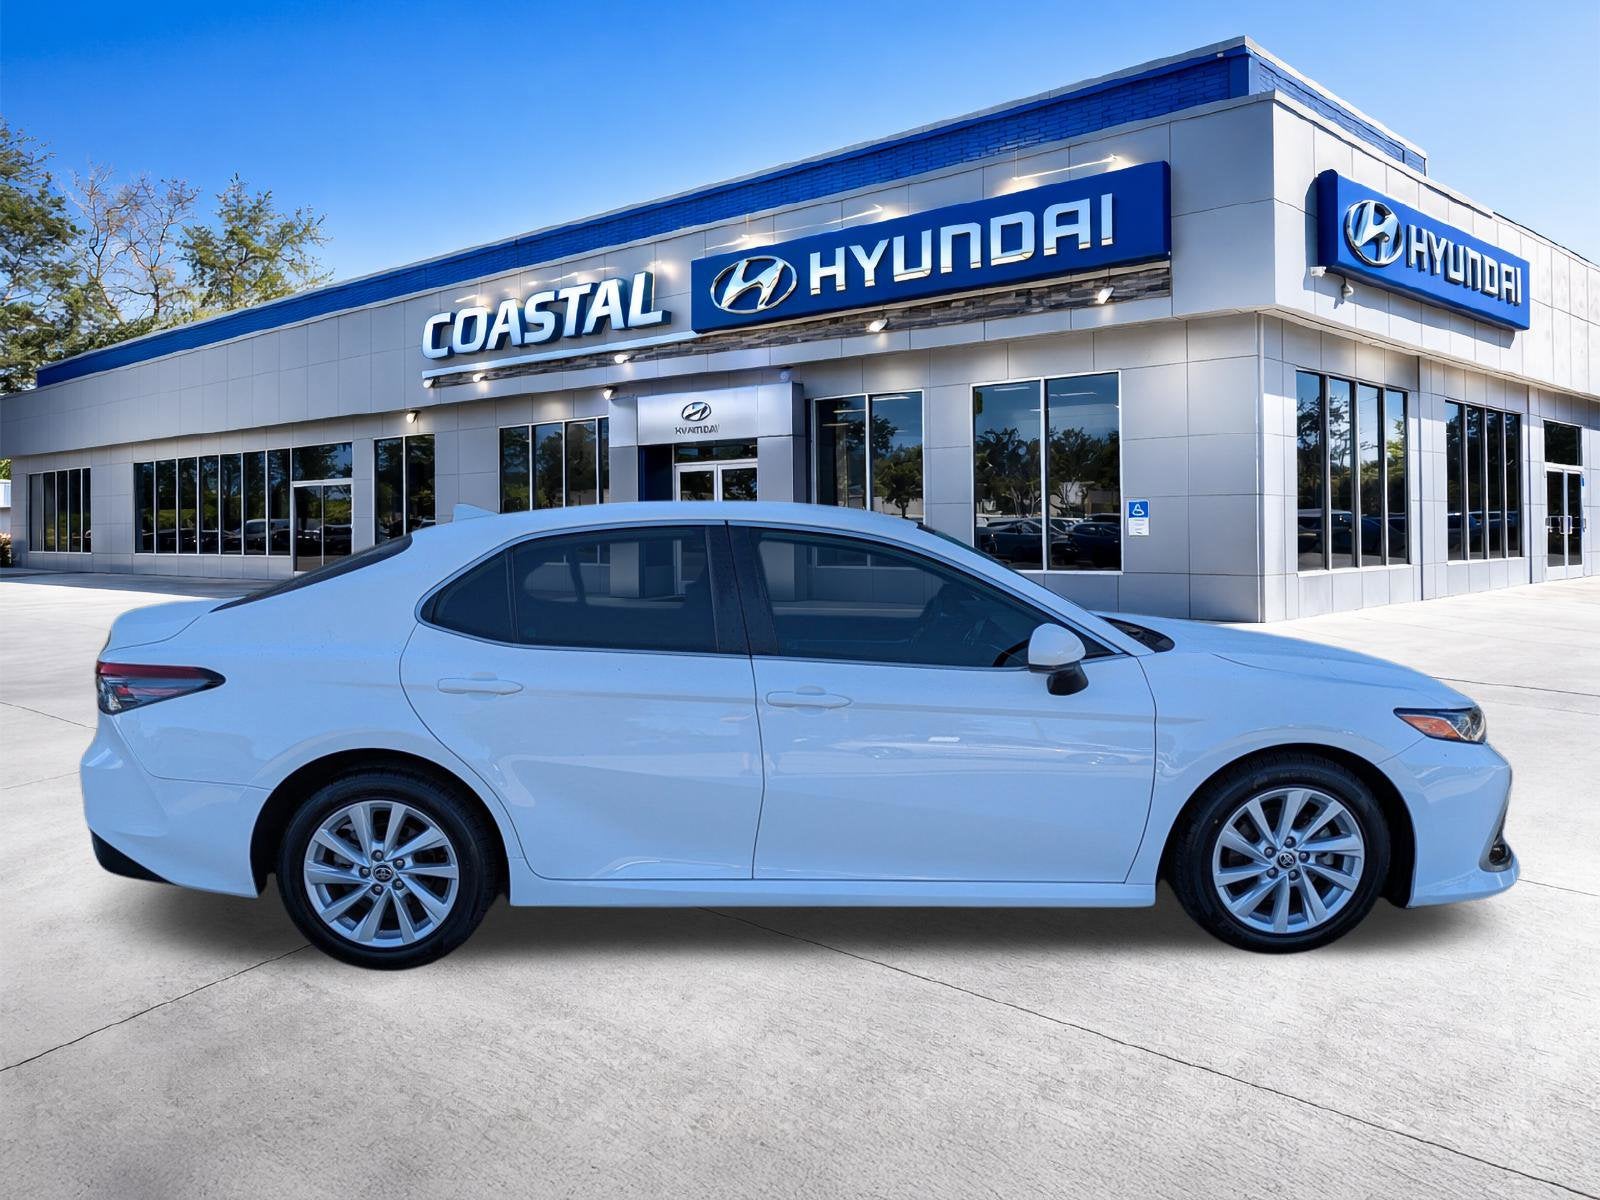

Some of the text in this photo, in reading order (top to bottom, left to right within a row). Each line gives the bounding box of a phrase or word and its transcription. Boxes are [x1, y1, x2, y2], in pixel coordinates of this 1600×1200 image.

[809, 193, 1113, 295] HYUNDAI
[1406, 224, 1521, 306] HYUNDAI
[422, 271, 669, 359] COASTAL
